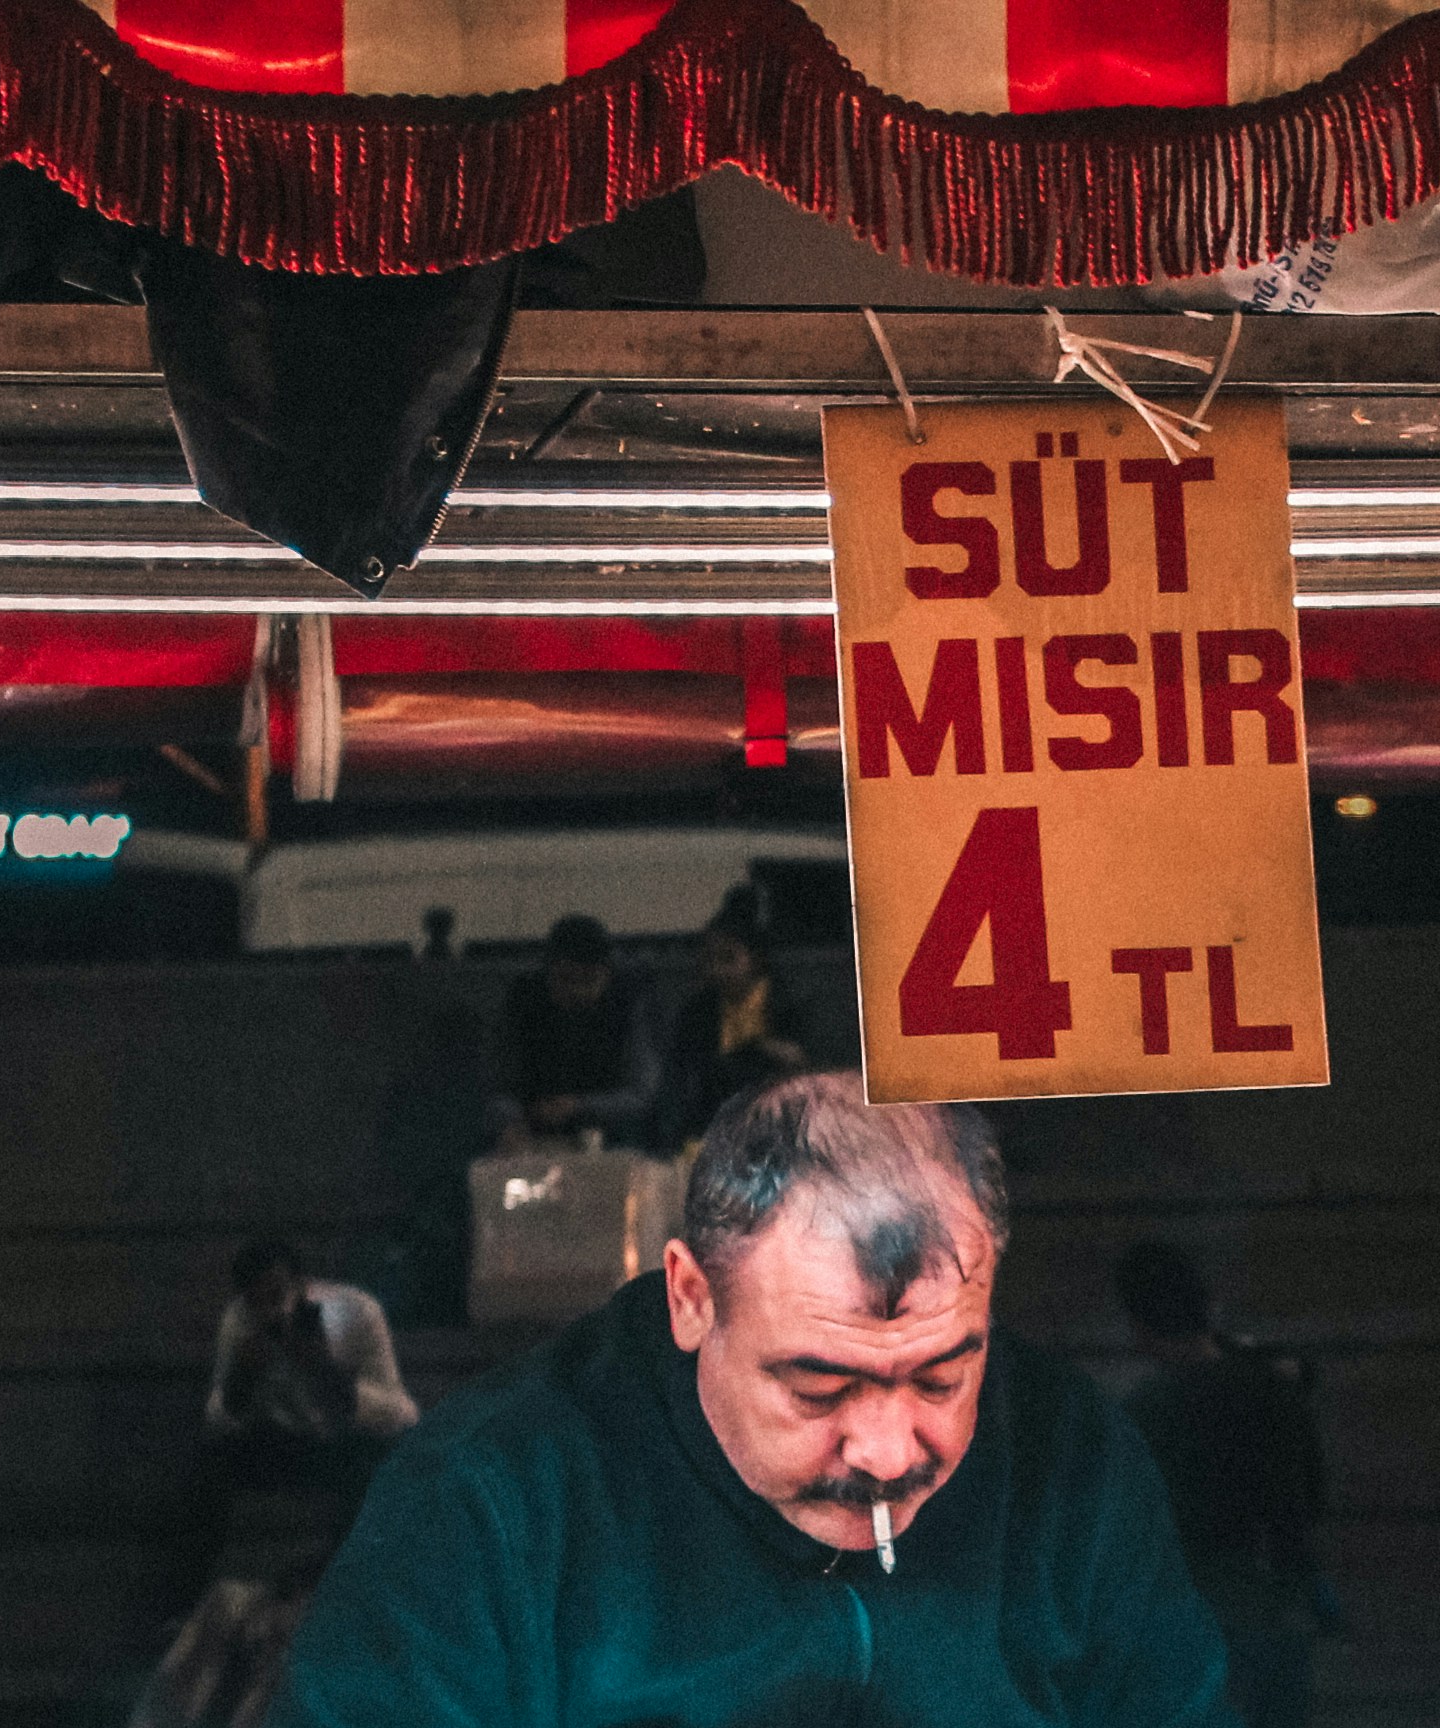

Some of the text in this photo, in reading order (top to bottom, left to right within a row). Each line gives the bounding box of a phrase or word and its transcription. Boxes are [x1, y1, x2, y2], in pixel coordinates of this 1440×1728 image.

[900, 432, 1215, 599] SÜT
[851, 628, 1298, 779] MISIR
[898, 806, 1294, 1060] 4 TL
